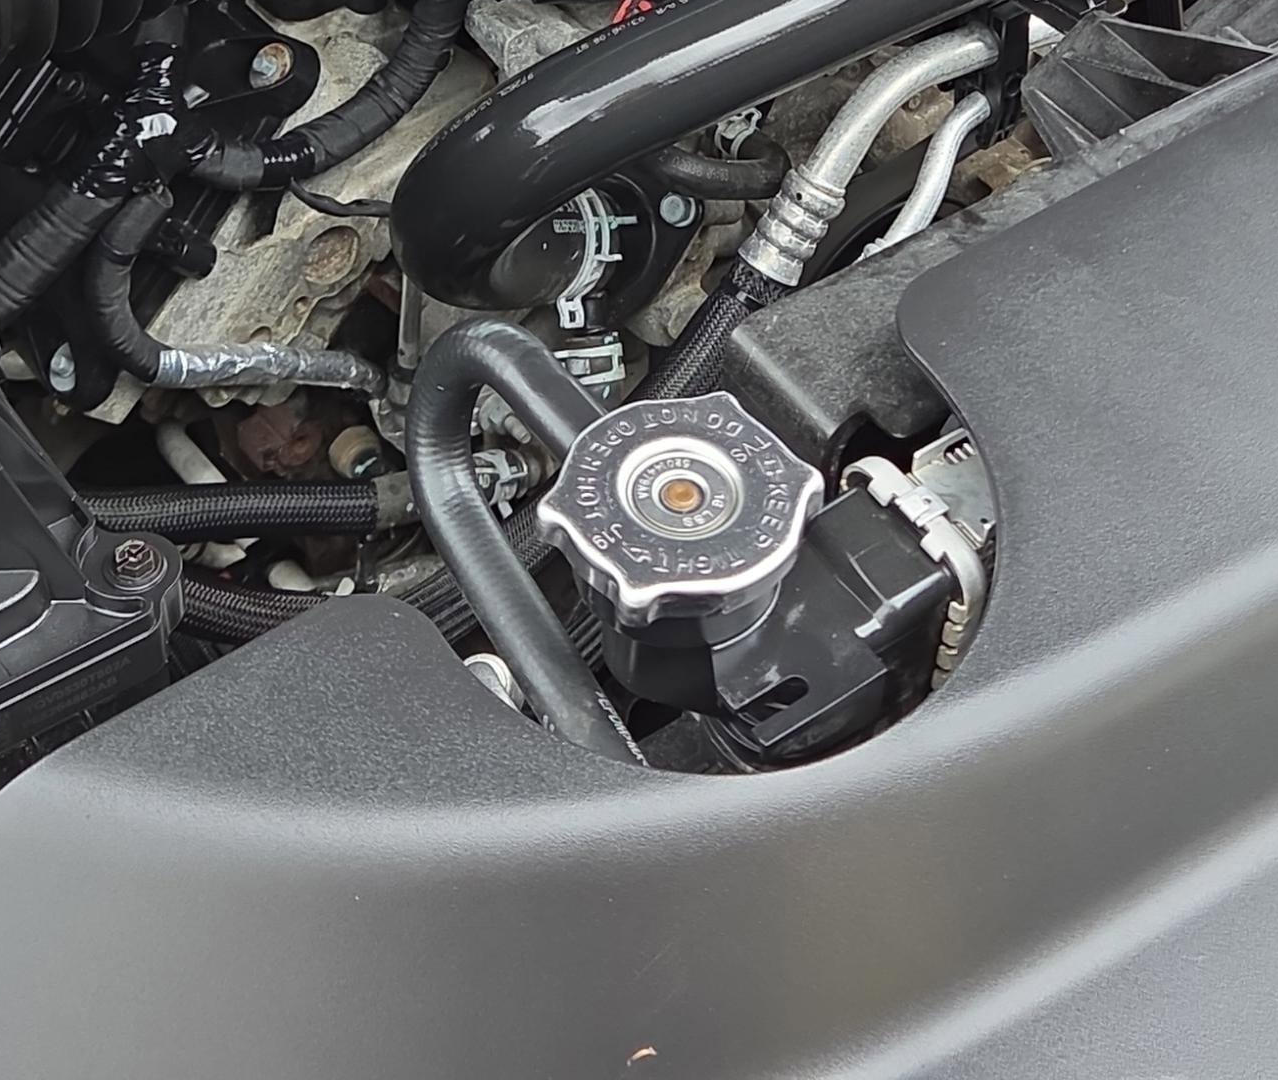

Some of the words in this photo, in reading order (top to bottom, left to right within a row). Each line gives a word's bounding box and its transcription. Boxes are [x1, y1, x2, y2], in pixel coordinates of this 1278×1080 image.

[642, 408, 699, 429] NOT
[706, 413, 744, 438] DO
[729, 435, 772, 464] TVS
[755, 482, 788, 549] KEEP
[651, 548, 745, 575] TIGHT
